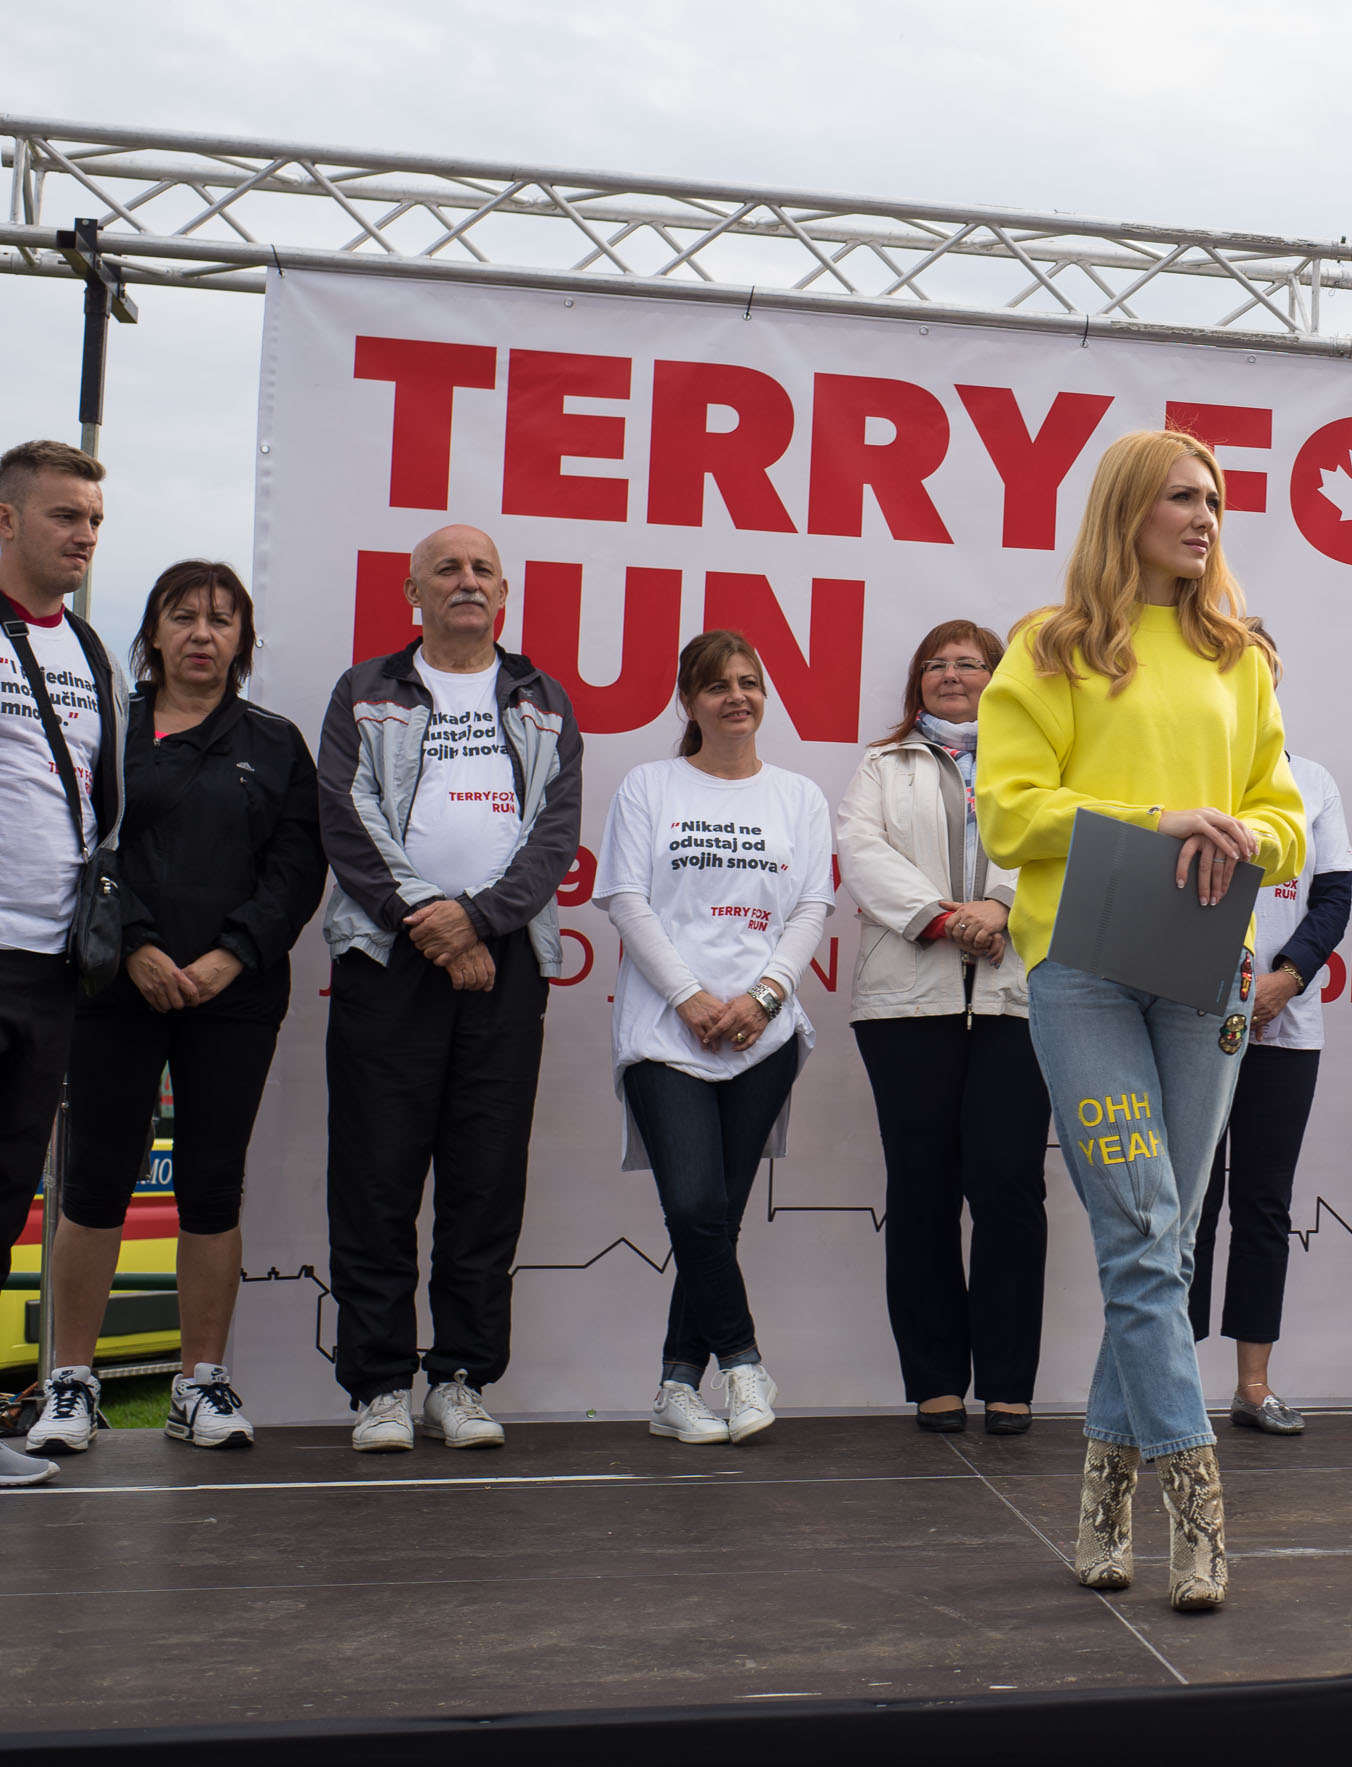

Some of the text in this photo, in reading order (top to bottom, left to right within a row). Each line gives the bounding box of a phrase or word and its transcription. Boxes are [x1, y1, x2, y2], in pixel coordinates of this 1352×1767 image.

[354, 335, 1115, 550] TERRY
[429, 712, 470, 726] ikad
[473, 727, 495, 739] od
[449, 791, 515, 802] TERRY FOX
[492, 803, 515, 813] RUN
[739, 826, 762, 836] ne
[669, 836, 766, 853] odustaj od
[671, 852, 723, 871] svojih
[1274, 887, 1297, 900] RUN
[711, 906, 772, 921] TERRY FOX
[747, 919, 768, 932] RUN
[1077, 1091, 1151, 1128] OHH
[1077, 1128, 1166, 1167] YEAH
